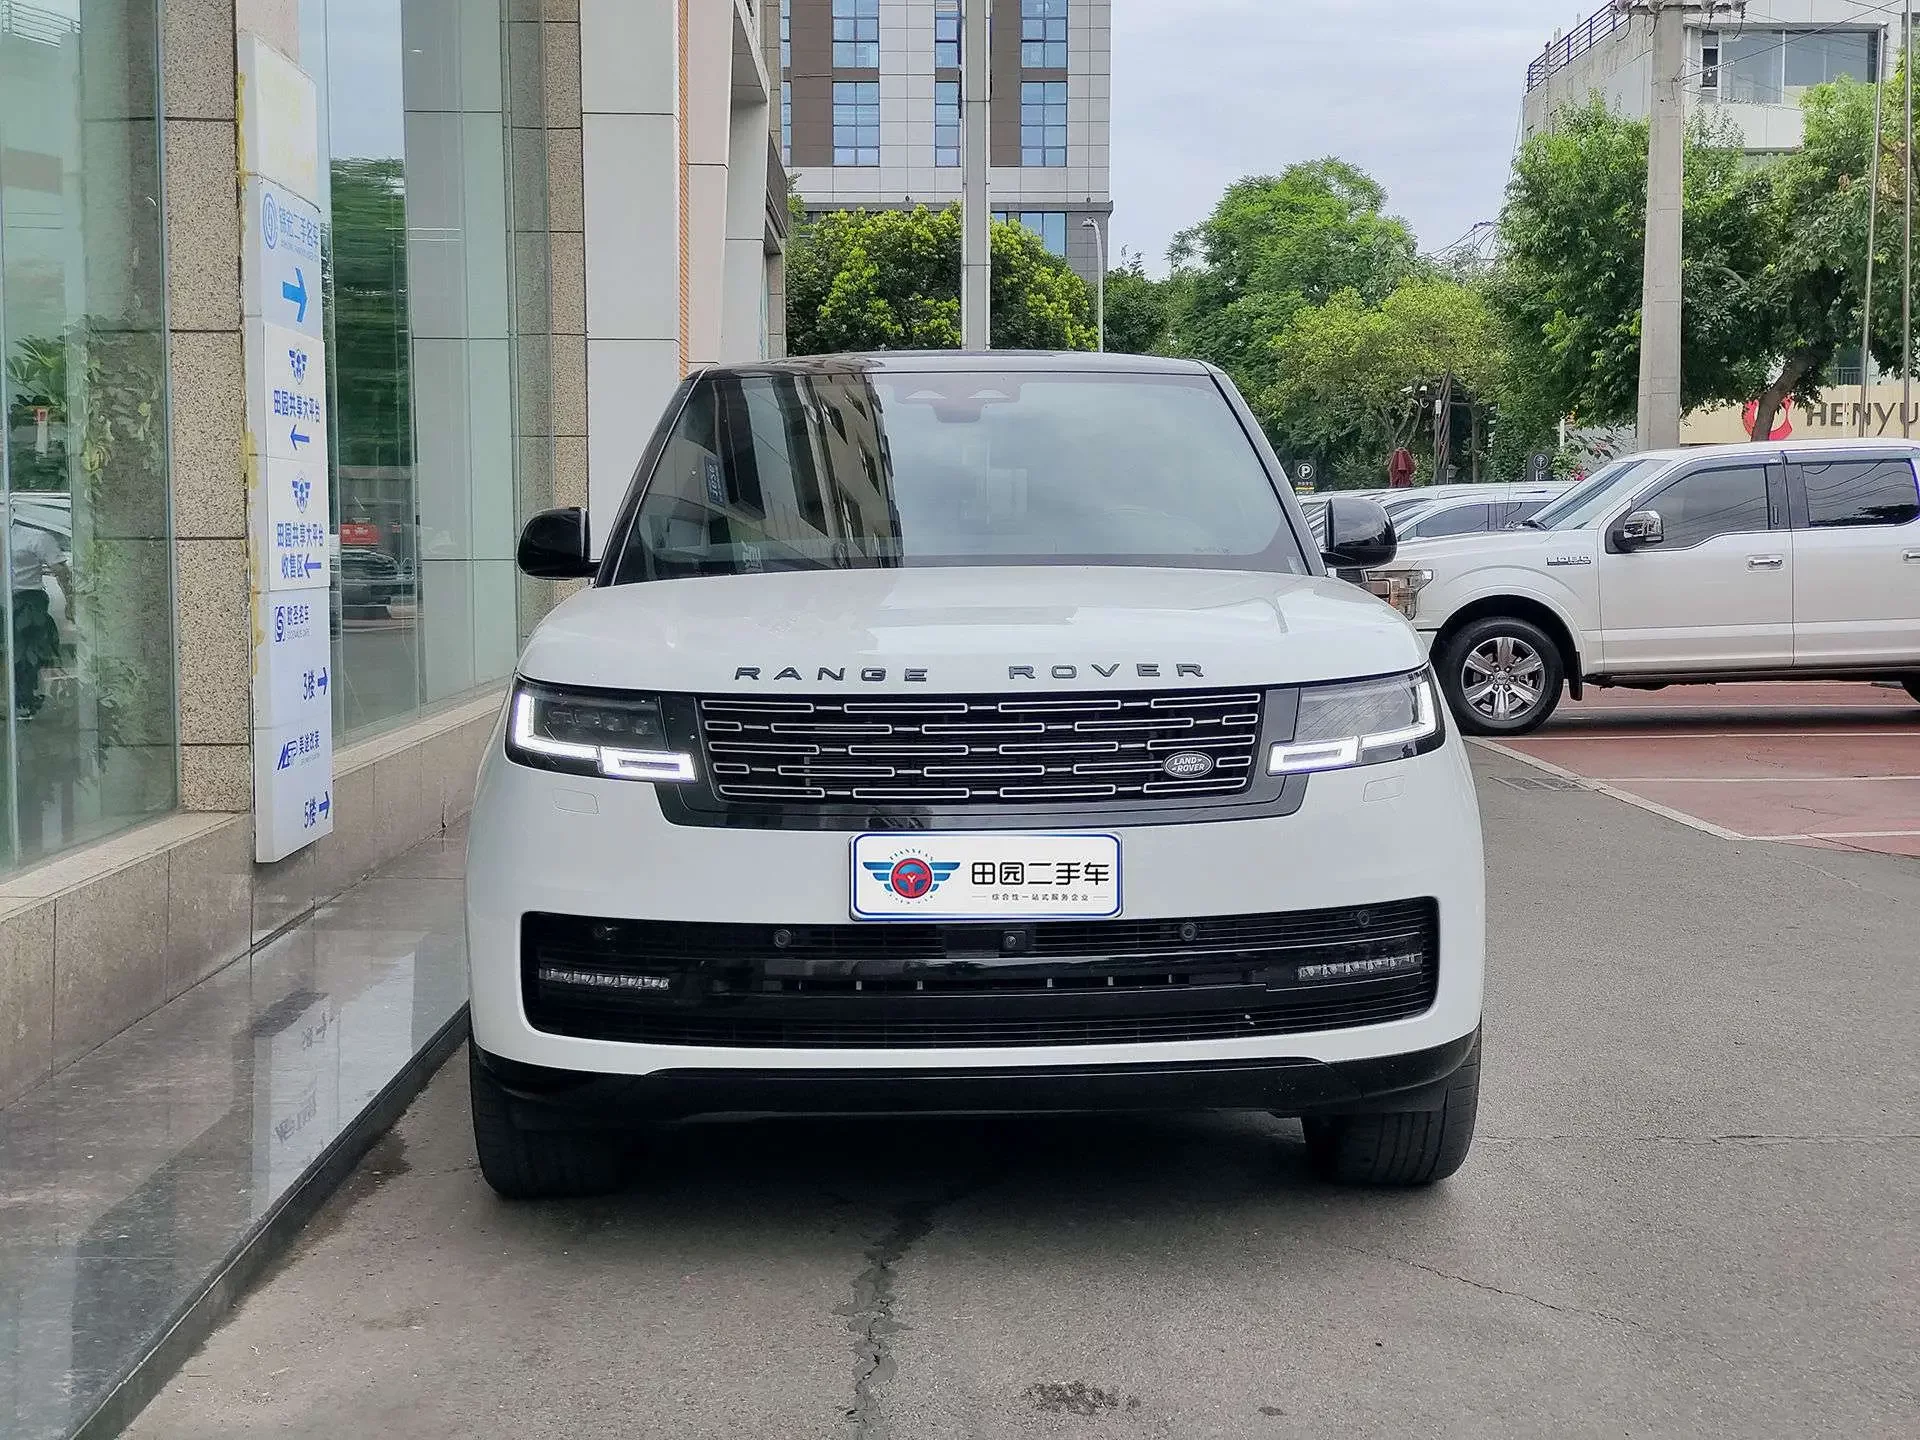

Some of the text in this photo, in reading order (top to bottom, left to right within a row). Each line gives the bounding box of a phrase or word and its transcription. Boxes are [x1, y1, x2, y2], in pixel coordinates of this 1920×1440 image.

[273, 389, 320, 424] 田园共享大平台
[277, 522, 324, 547] 田园共享大平台
[281, 552, 304, 579] 收售区
[303, 670, 315, 700] 3楼
[734, 663, 1205, 682] RANGE ROVER
[1173, 756, 1198, 766] LAND
[1176, 763, 1206, 772] ROVER
[972, 861, 1110, 886] 田园二手车
[991, 893, 1090, 902] 综合性一站式服务企业
